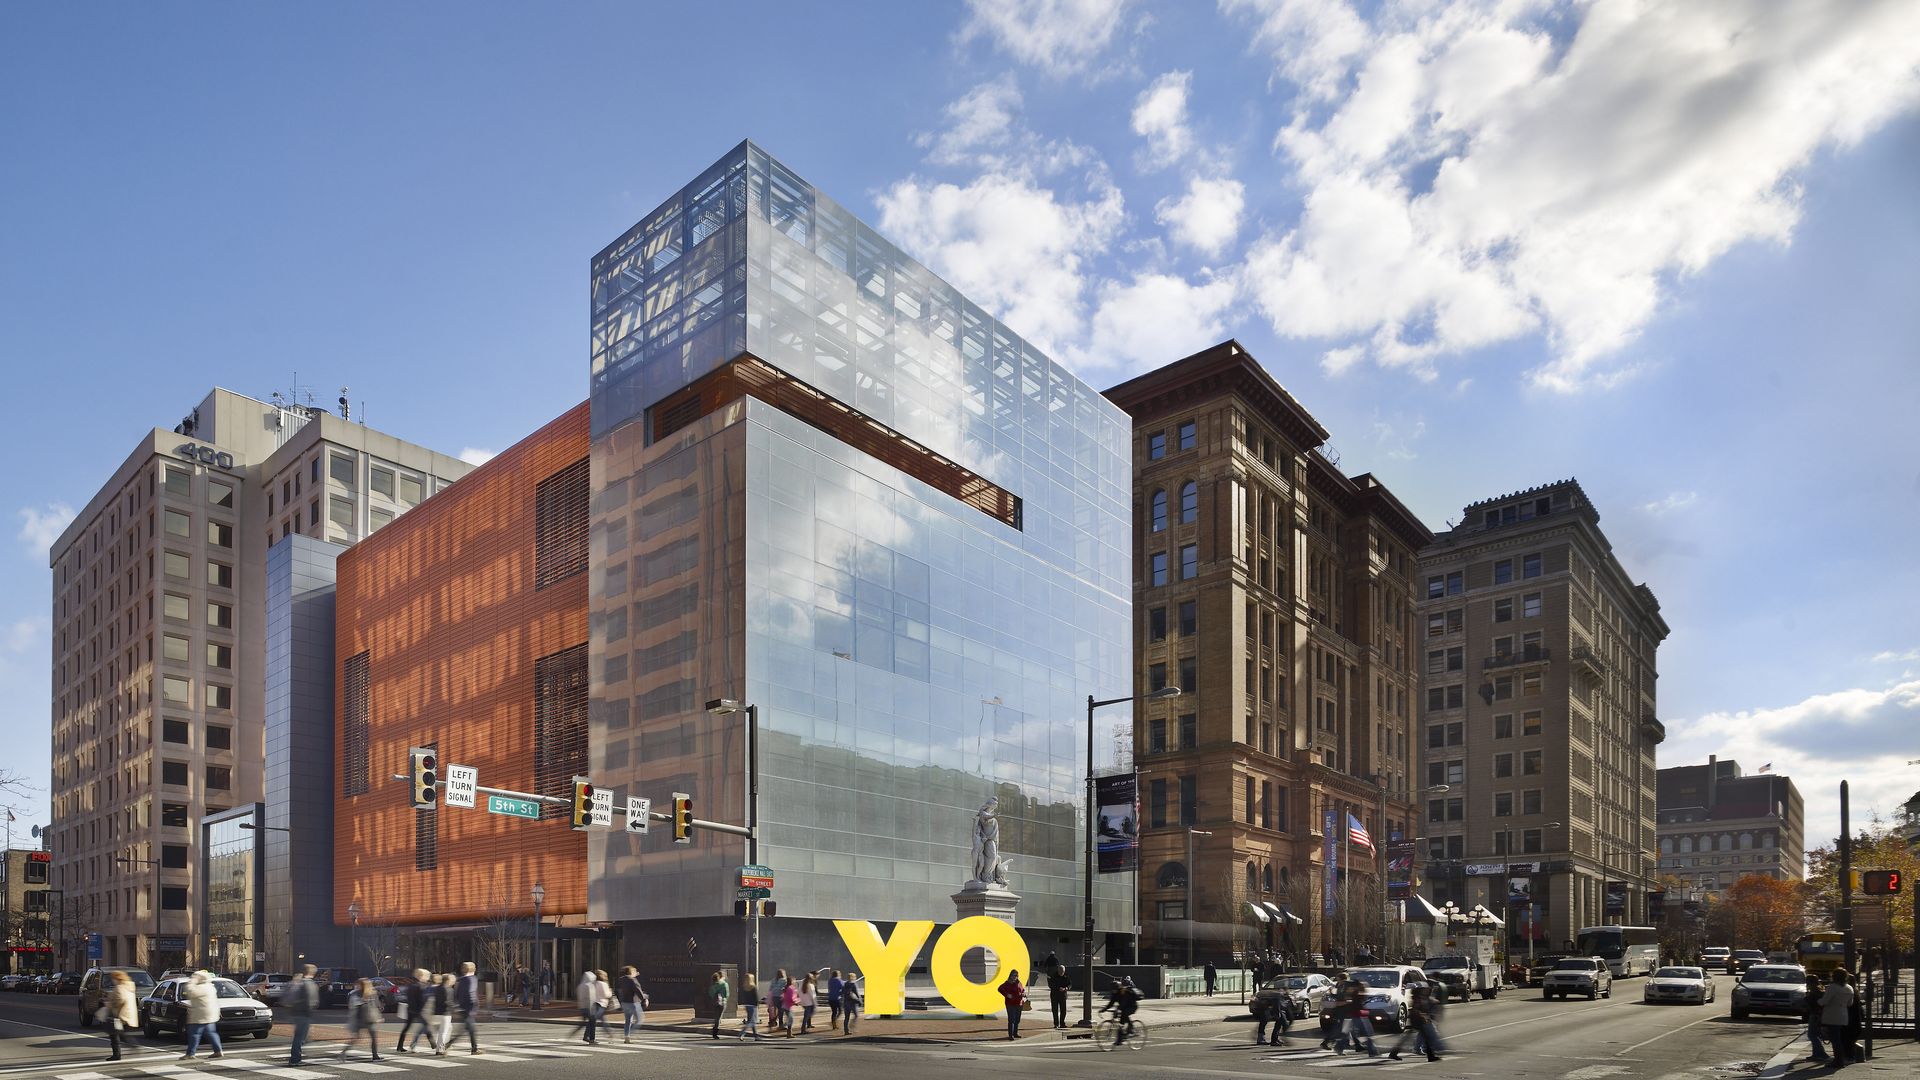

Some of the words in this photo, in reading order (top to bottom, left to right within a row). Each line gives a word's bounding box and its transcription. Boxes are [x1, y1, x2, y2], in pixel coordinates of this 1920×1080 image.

[181, 442, 234, 470] 400
[452, 769, 472, 780] LEFT
[451, 781, 472, 791] TURN
[448, 792, 473, 803] SIGNAL
[592, 793, 609, 802] LEFT
[495, 800, 515, 813] 5th
[520, 804, 533, 815] St
[631, 799, 646, 809] ONE
[630, 810, 646, 818] WAY
[1888, 873, 1898, 891] 2
[832, 915, 1030, 1015] YO
